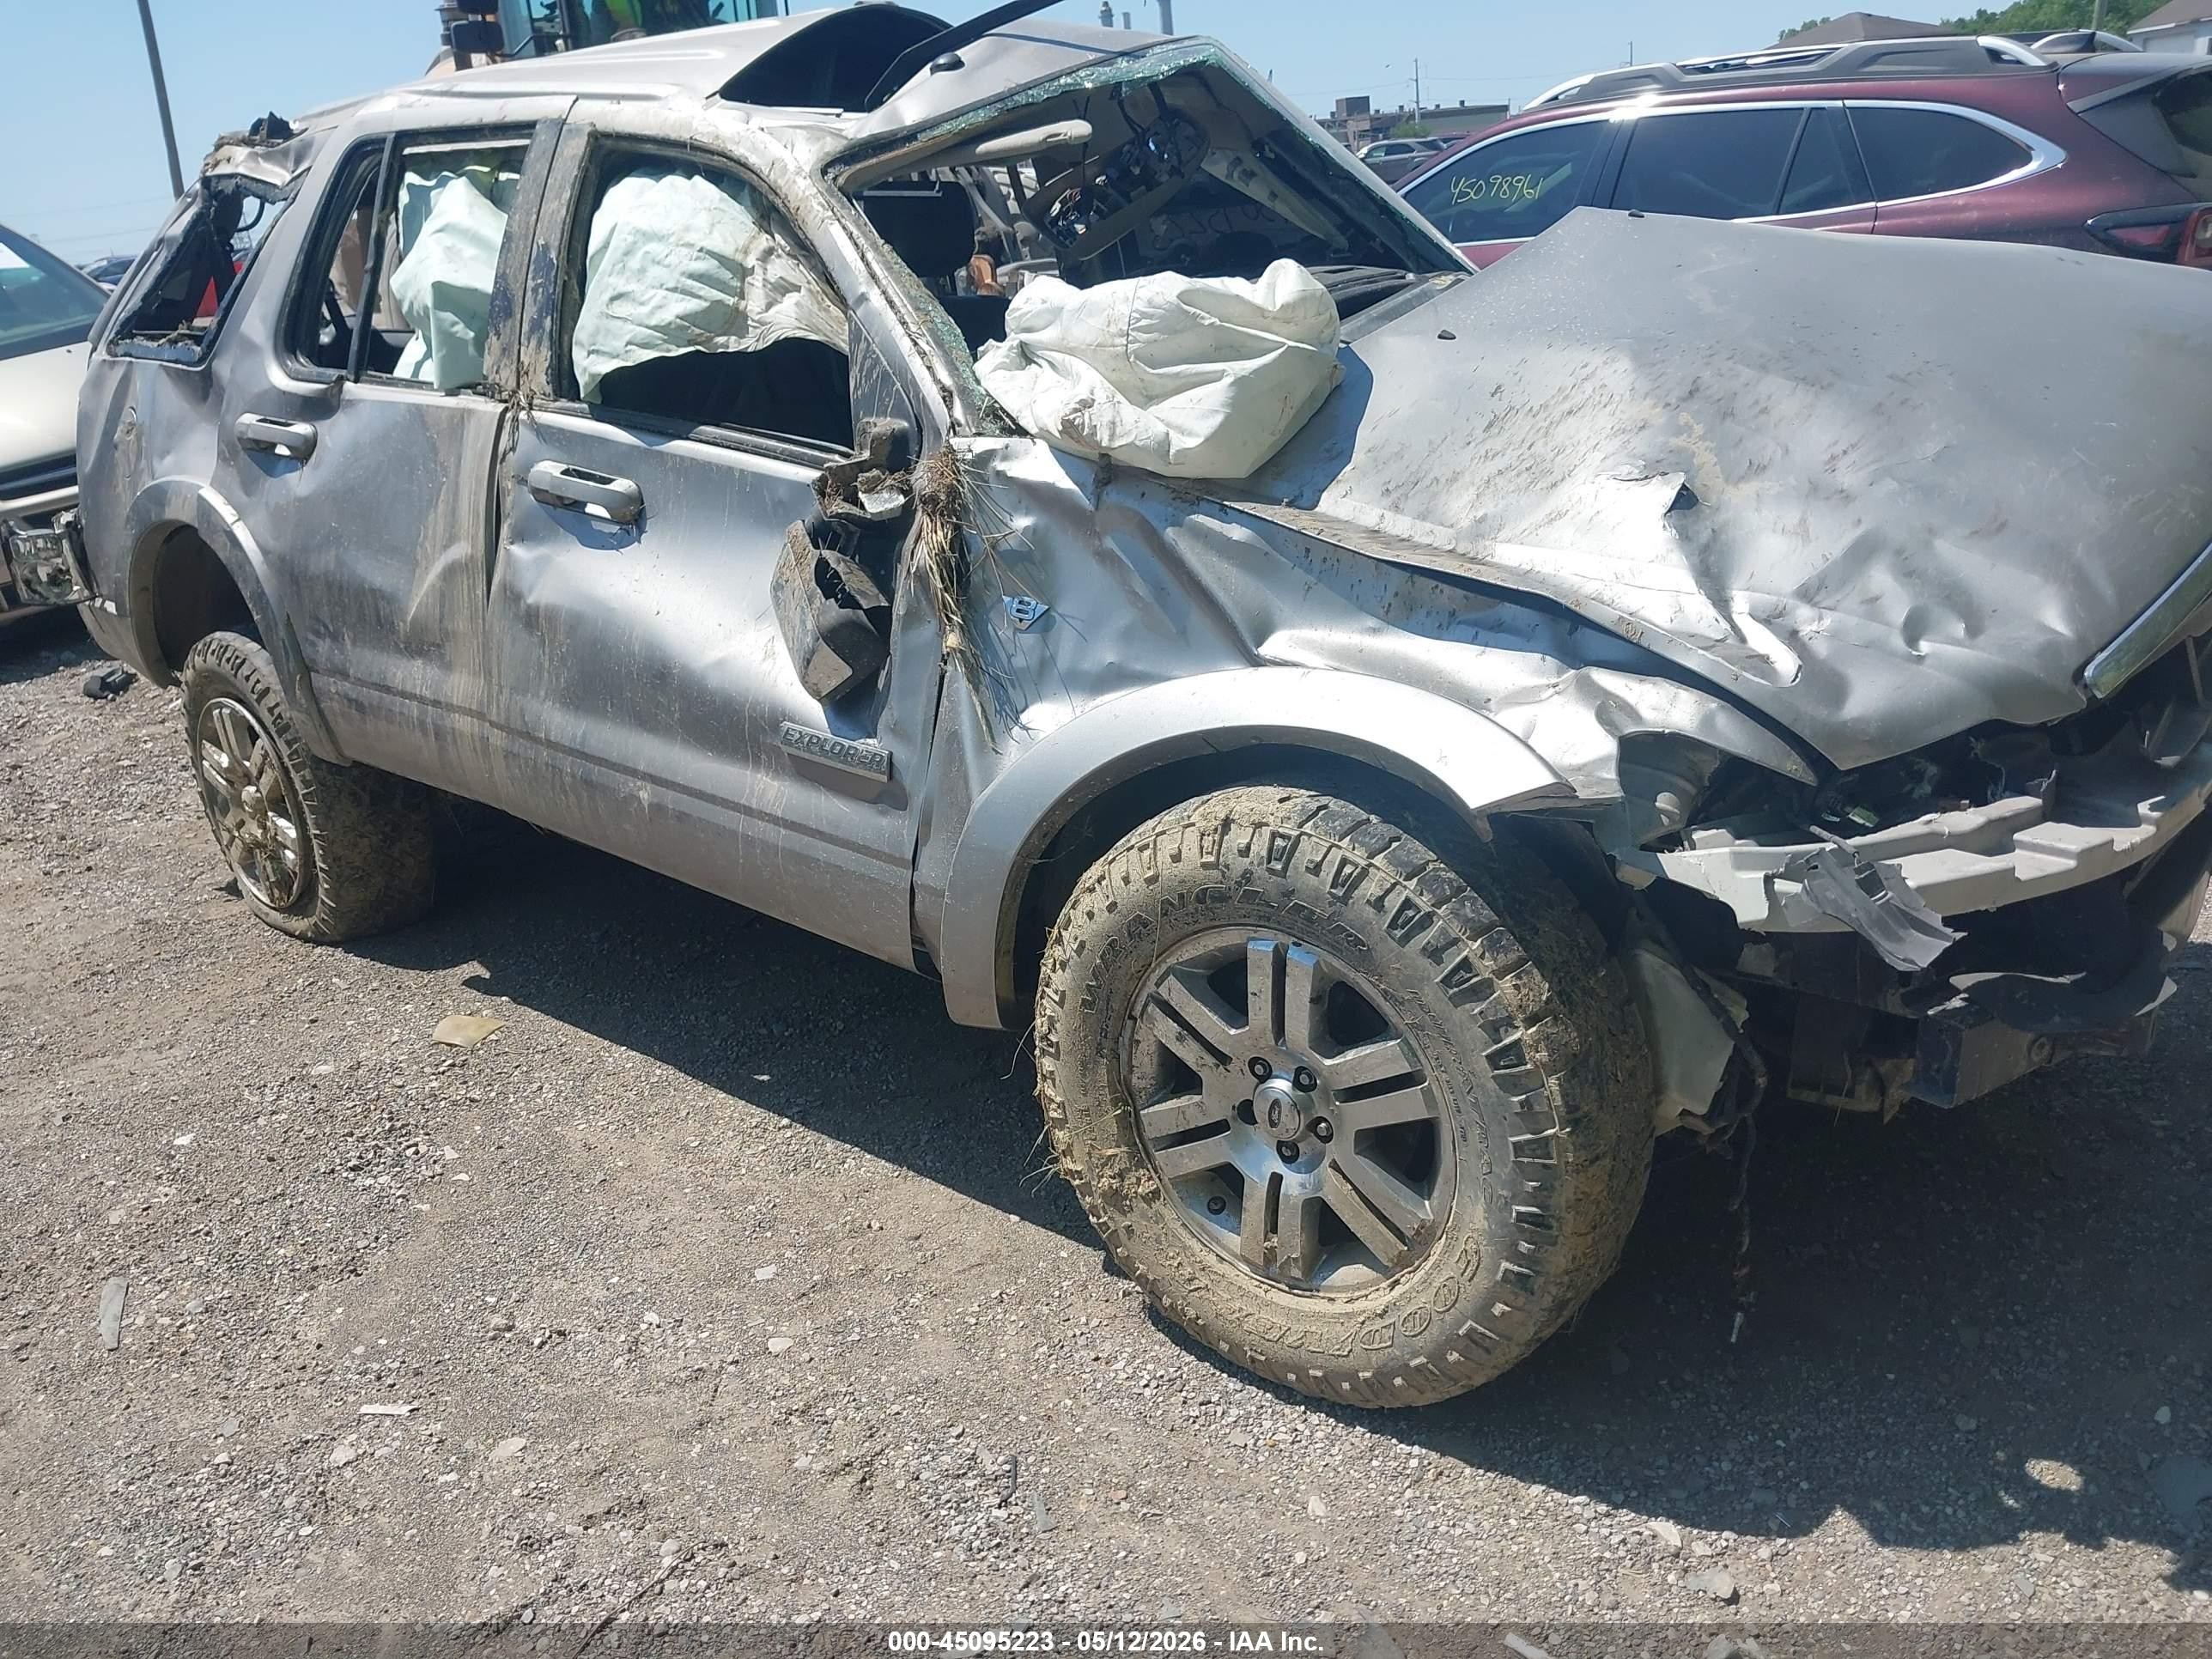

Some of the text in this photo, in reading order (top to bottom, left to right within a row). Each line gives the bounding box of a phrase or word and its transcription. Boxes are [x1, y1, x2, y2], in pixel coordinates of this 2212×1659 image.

[1450, 174, 1544, 205] 45098961
[781, 726, 887, 771] EXPLORER
[1080, 884, 1370, 1014] WRANGLER
